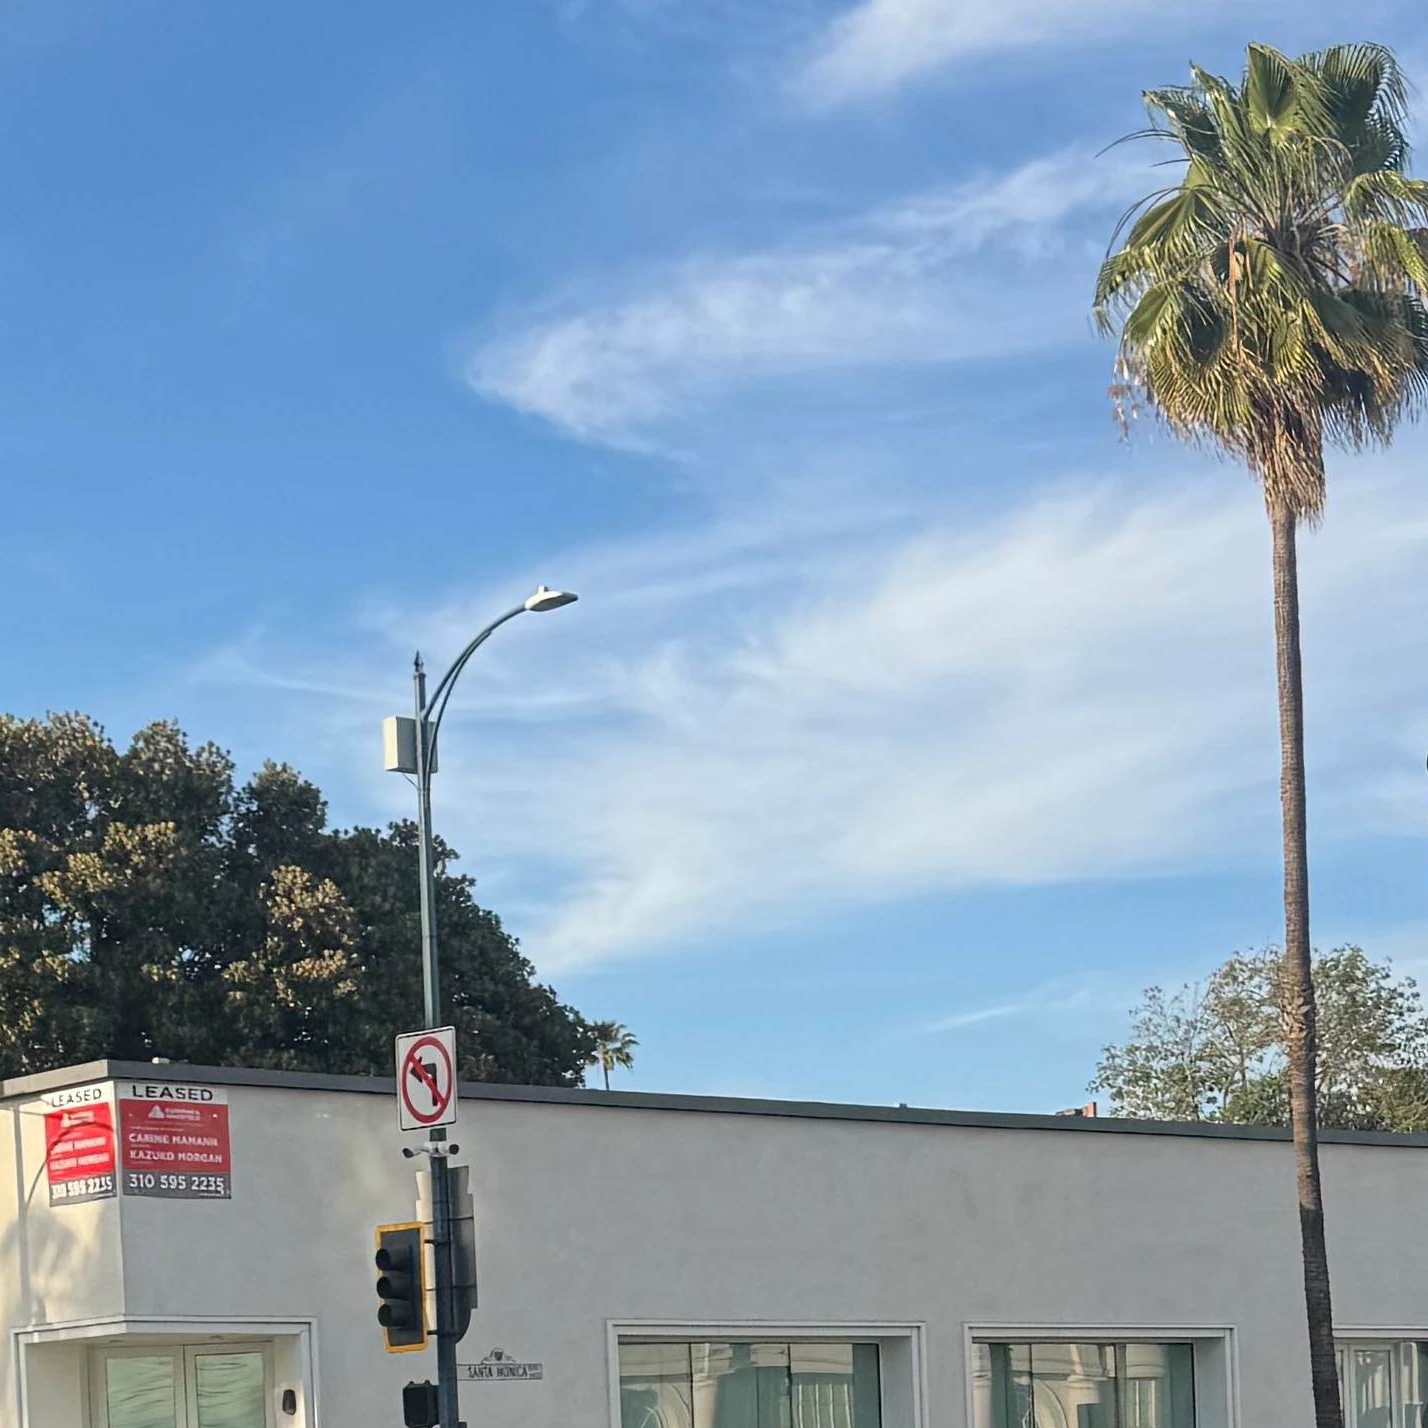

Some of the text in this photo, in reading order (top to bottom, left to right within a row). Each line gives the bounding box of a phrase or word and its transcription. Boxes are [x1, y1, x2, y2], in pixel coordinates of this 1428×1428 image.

[51, 1088, 102, 1107] LEASED
[132, 1085, 213, 1101] LEASED
[130, 1150, 223, 1164] KAZUKO MORGAN
[129, 1174, 224, 1191] 310 595 2235
